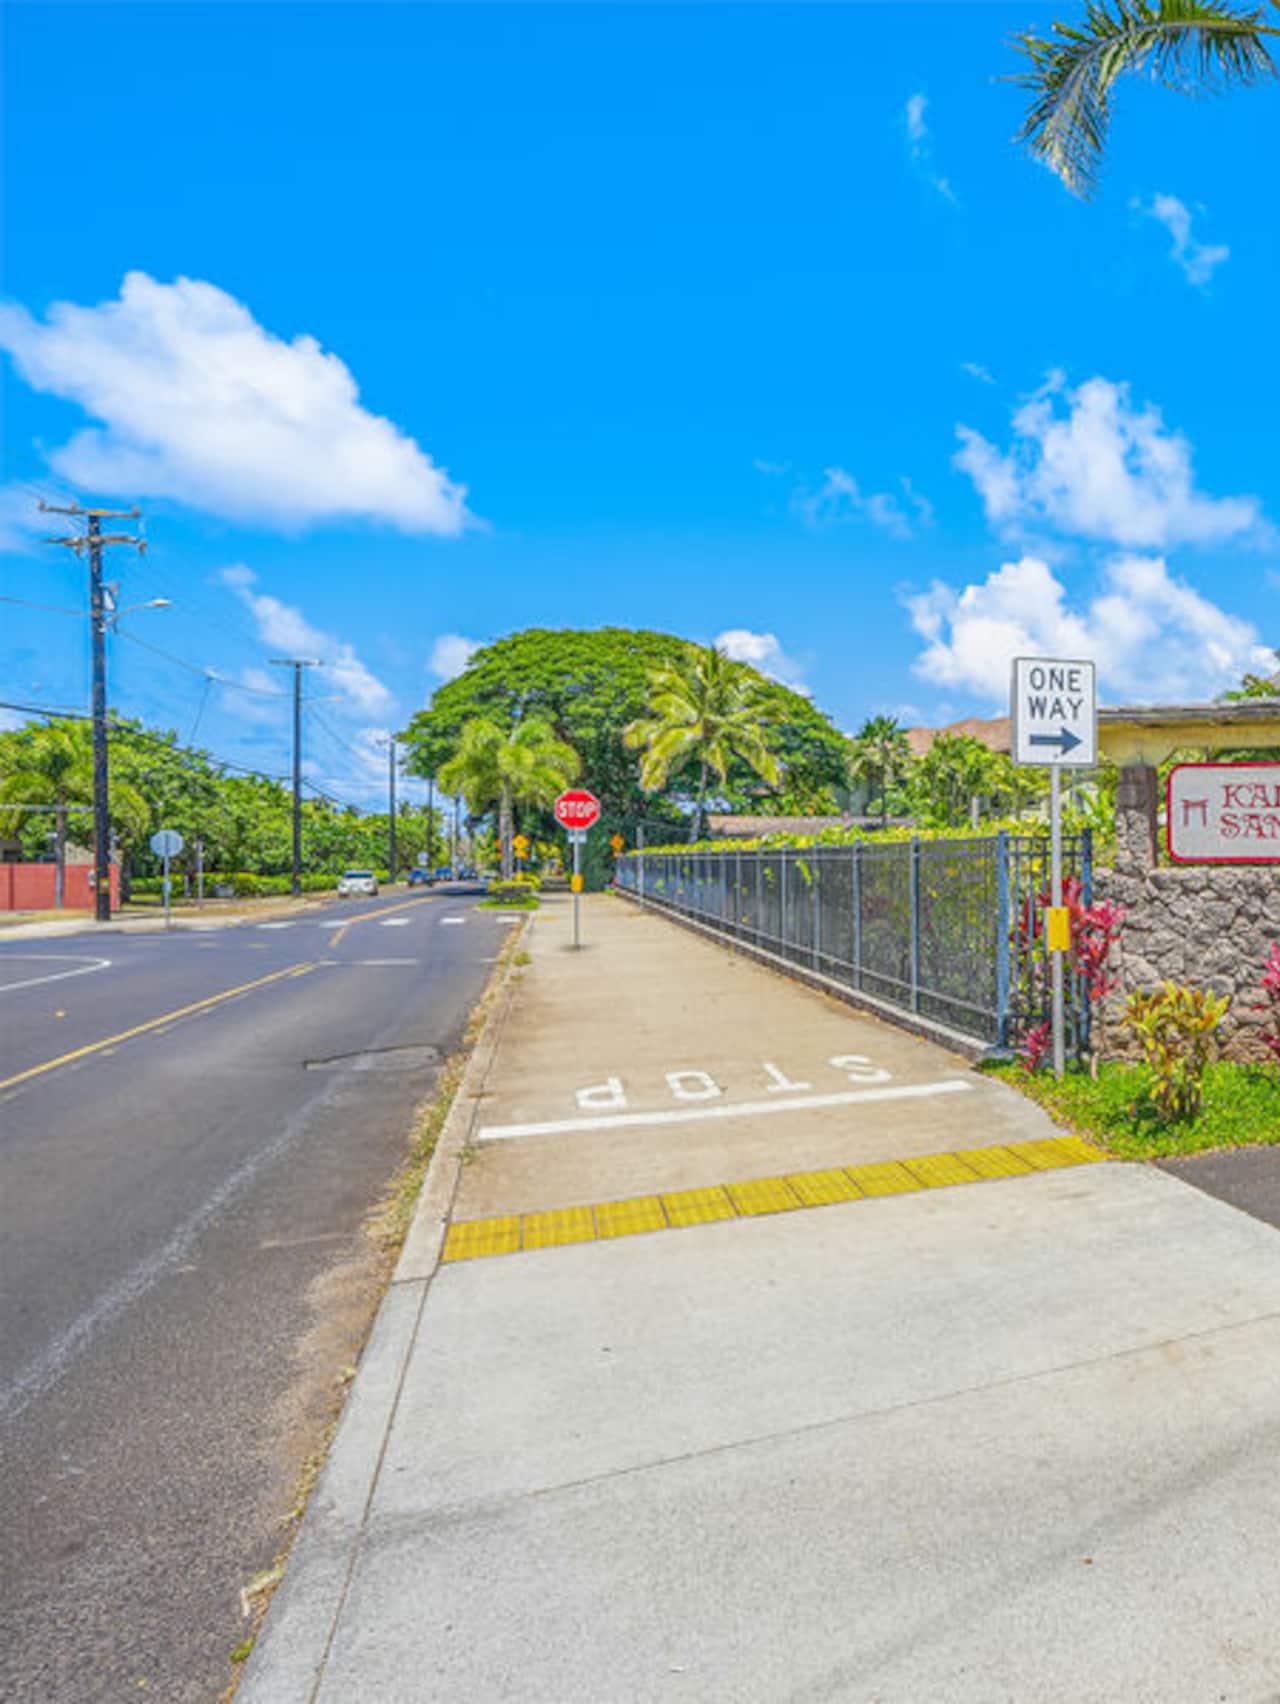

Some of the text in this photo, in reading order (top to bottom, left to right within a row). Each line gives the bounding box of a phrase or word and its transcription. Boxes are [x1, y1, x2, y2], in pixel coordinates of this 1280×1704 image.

[1029, 667, 1082, 692] ONE
[1028, 696, 1084, 720] WAY
[559, 801, 595, 818] STOP
[574, 1054, 893, 1109] STOP
